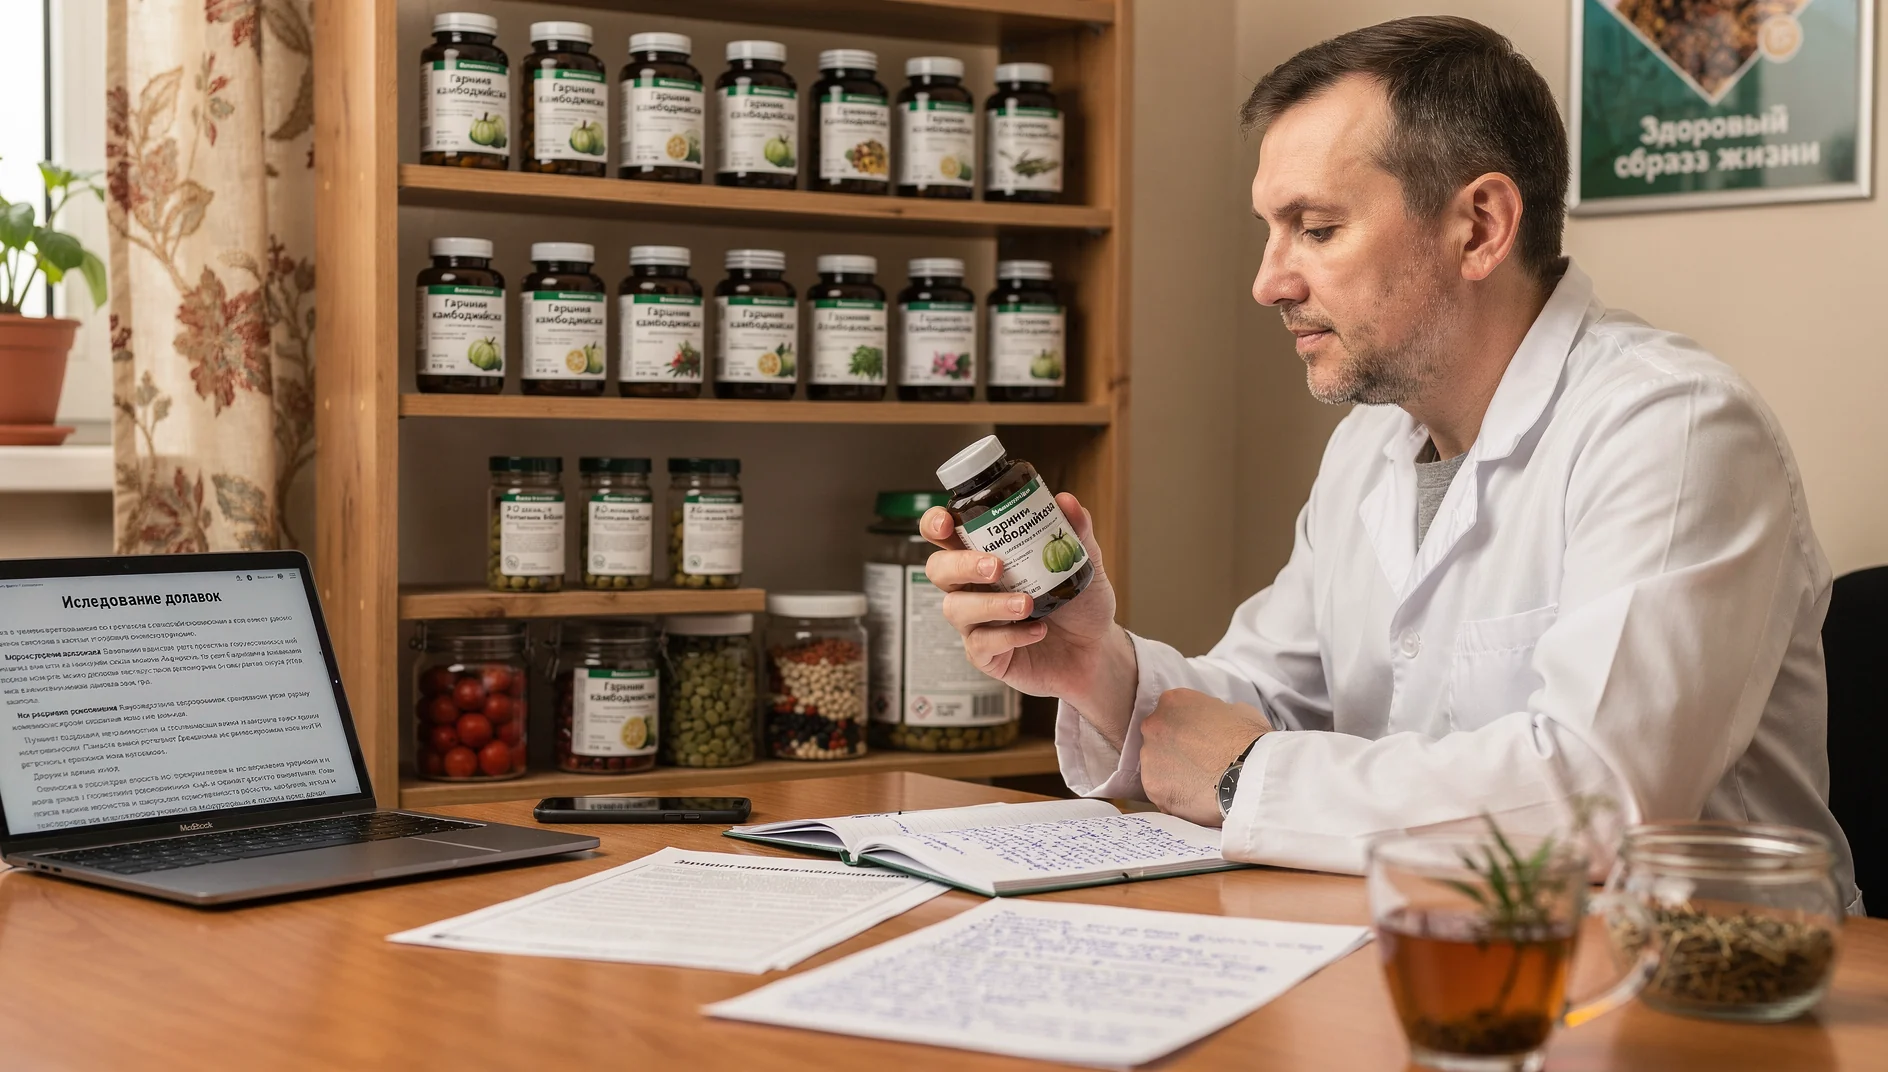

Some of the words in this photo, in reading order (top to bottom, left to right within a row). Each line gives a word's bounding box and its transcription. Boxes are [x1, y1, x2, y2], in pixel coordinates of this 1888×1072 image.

[1640, 104, 1789, 148] Здоровый
[1716, 141, 1821, 171] жизни
[61, 593, 162, 610] Иследование
[165, 591, 222, 606] долавок
